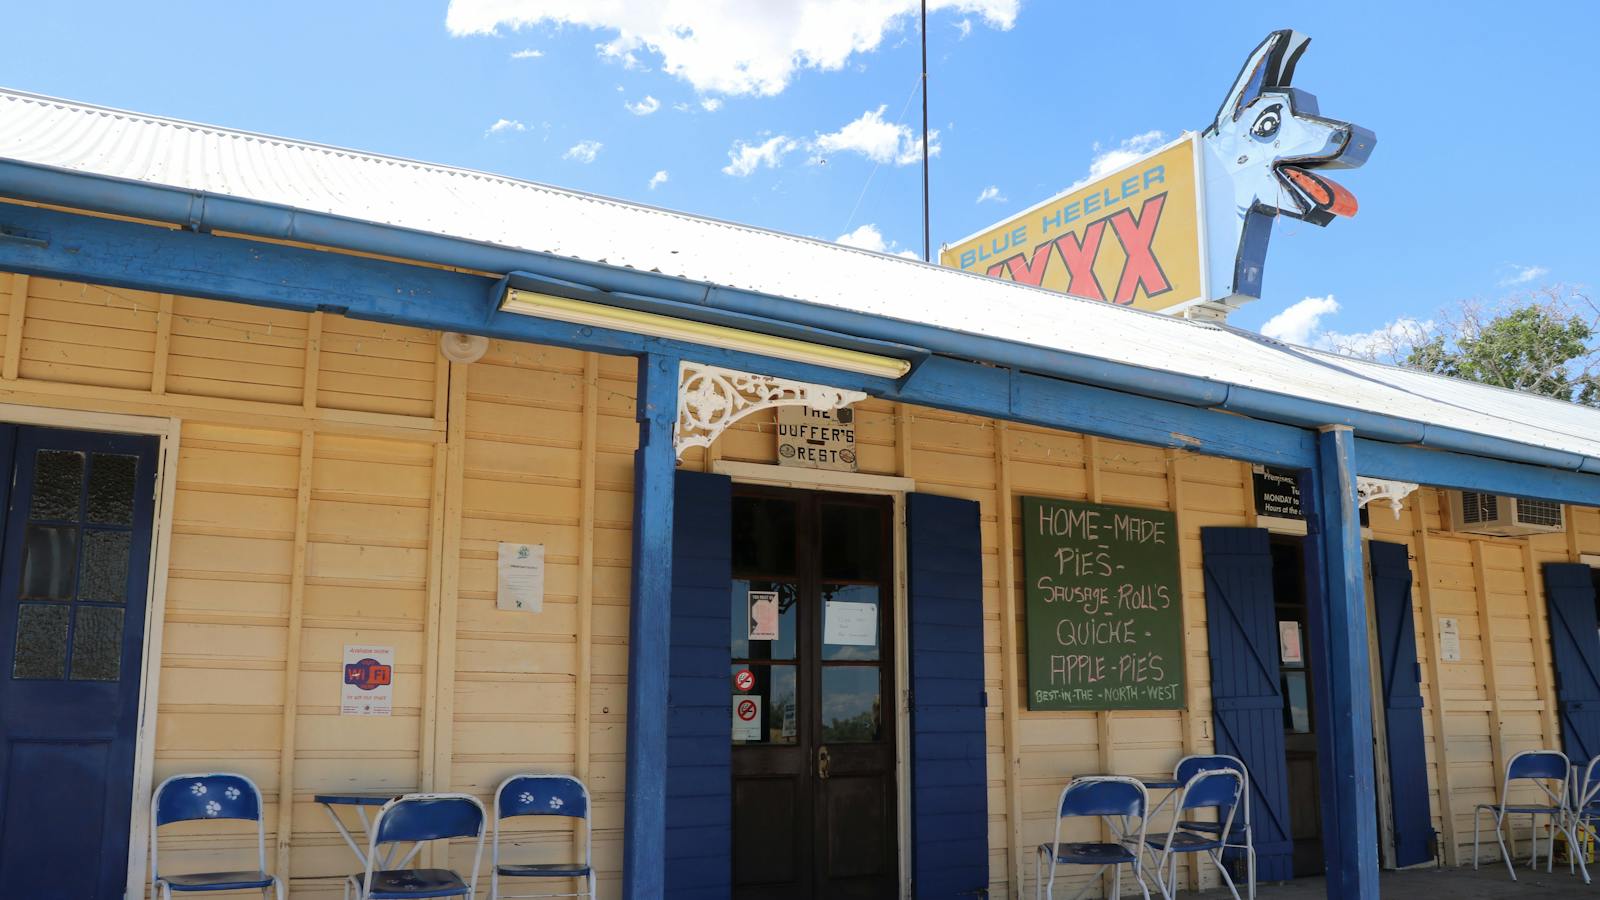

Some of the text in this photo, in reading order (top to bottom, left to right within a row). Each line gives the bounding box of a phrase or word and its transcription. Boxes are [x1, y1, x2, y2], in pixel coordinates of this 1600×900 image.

[960, 164, 1166, 269] BLUE HEELER
[797, 446, 838, 463] REST
[1263, 493, 1293, 505] MONDAY
[1264, 503, 1282, 513] Hours
[1282, 506, 1289, 514] at
[1289, 506, 1298, 515] the
